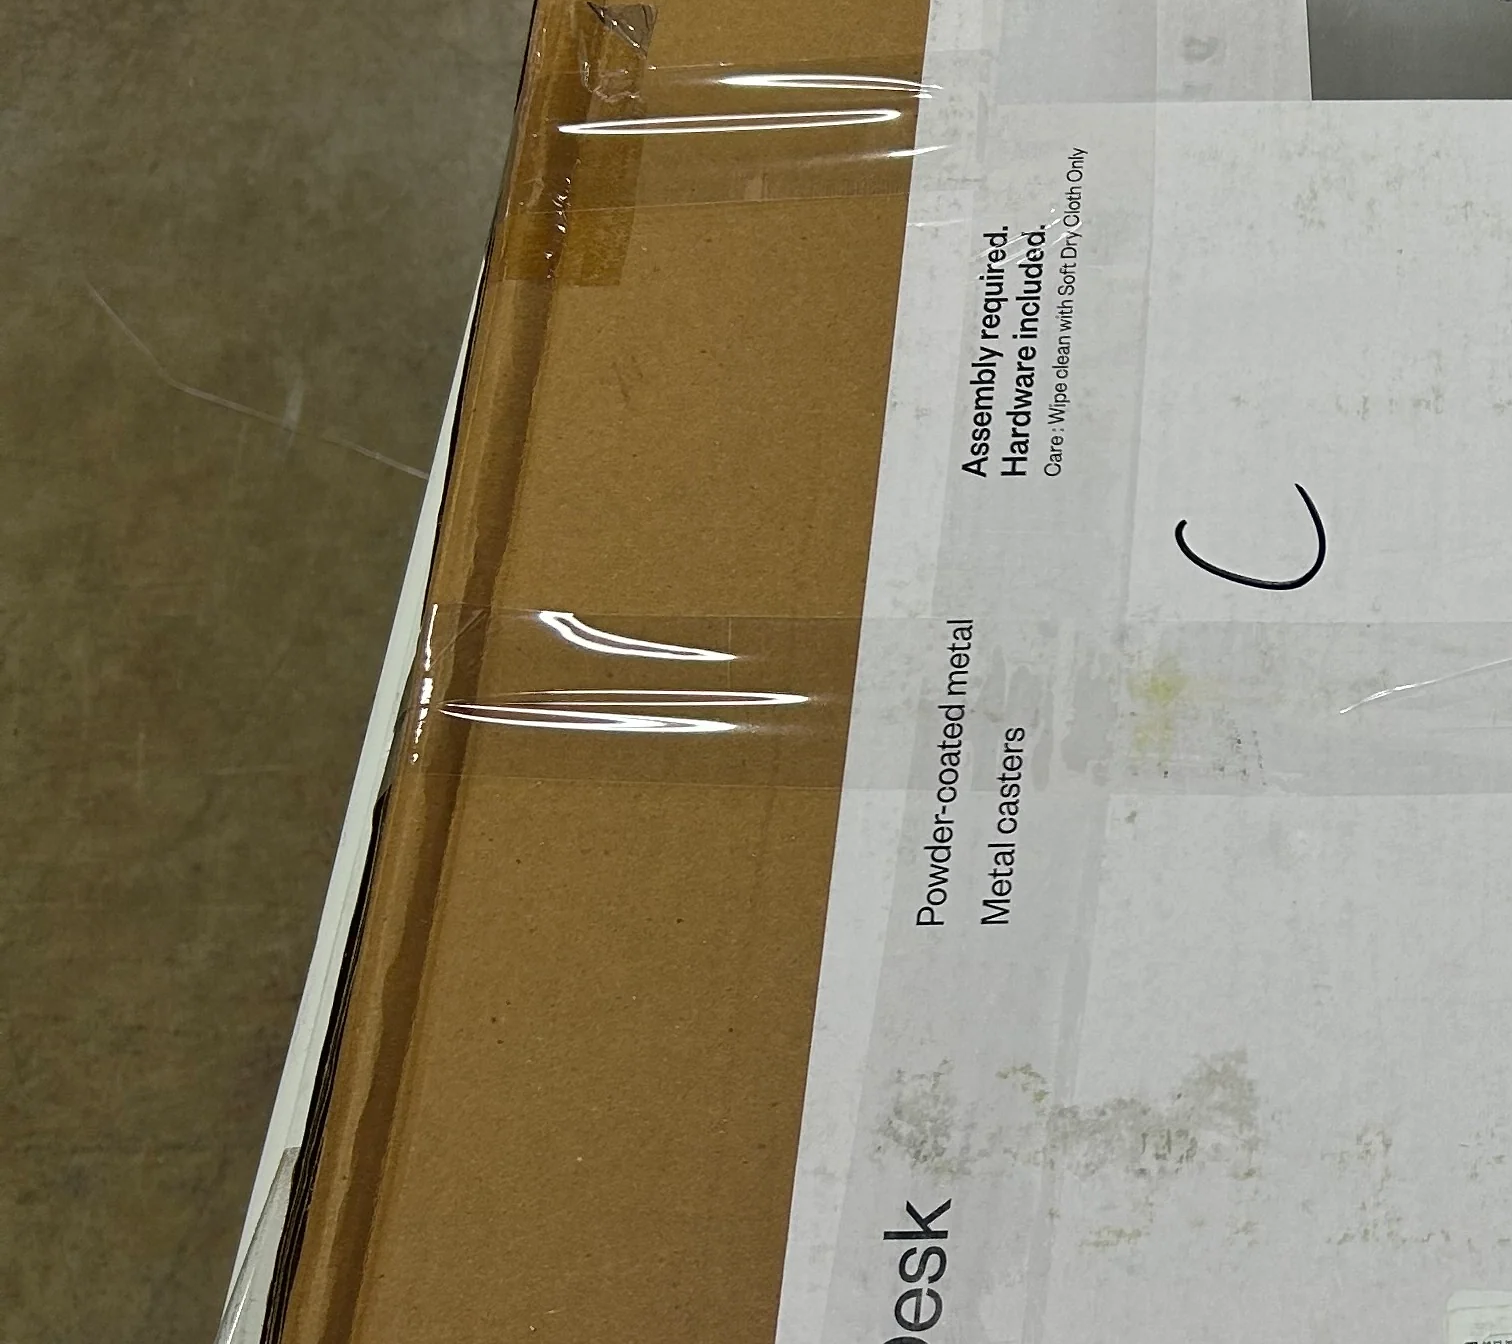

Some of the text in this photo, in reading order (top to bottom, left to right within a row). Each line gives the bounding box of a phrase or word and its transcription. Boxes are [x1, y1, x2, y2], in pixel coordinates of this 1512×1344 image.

[1066, 147, 1088, 183] Only
[1063, 186, 1081, 228] Cloth
[1061, 231, 1081, 259] Dry
[1058, 262, 1077, 297] Soft
[1055, 304, 1074, 333] with
[961, 225, 1009, 478] Assembly required.
[1000, 224, 1046, 477] Hardware included.
[1052, 335, 1071, 378] clean
[1049, 381, 1071, 425] Wipe
[916, 619, 974, 926] Powder-coated metal
[980, 726, 1026, 925] Metal casters
